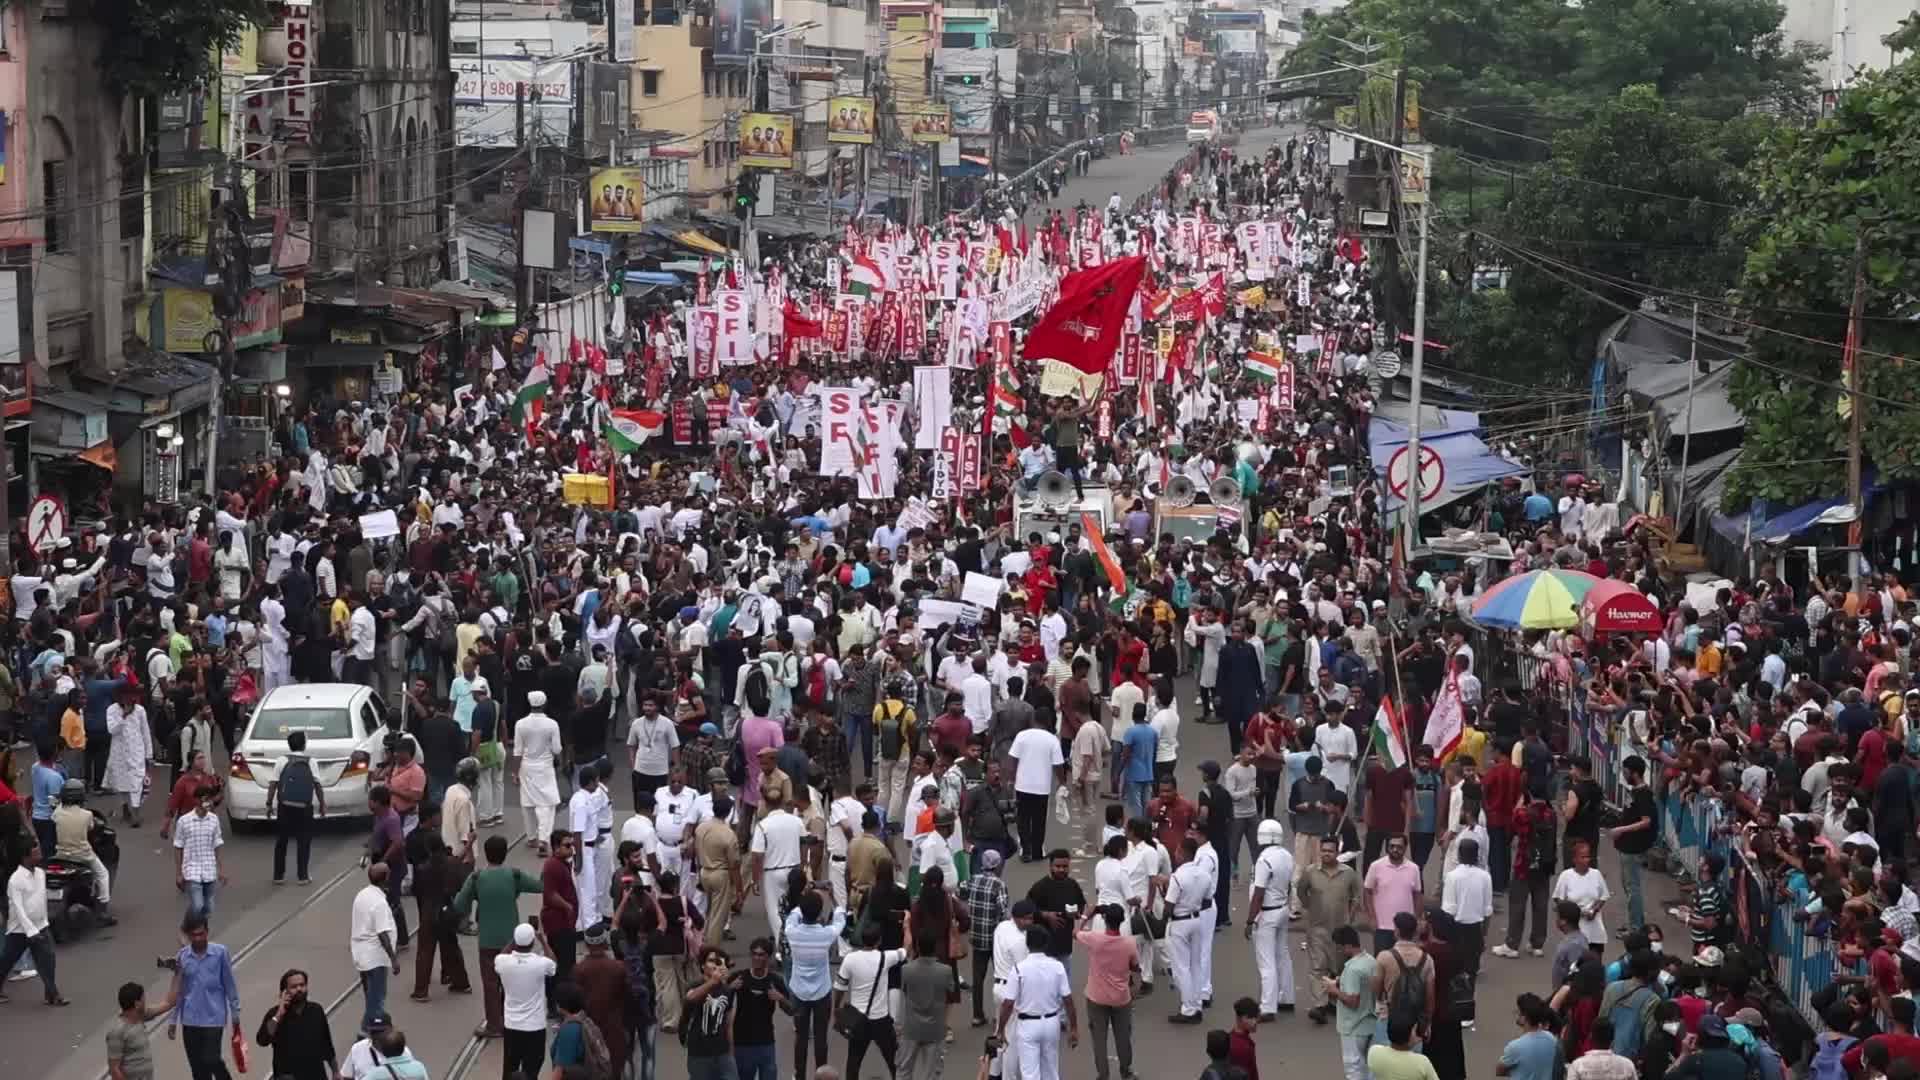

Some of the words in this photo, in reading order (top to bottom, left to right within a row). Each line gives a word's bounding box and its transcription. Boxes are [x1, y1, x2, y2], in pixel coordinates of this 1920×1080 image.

[288, 23, 305, 116] HOTEL
[724, 295, 741, 357] SFI
[1320, 332, 1337, 370] AISA
[1279, 363, 1291, 406] AISA
[934, 452, 946, 496] AIDYO
[962, 436, 977, 485] AISA
[1608, 607, 1653, 619] Havmor
